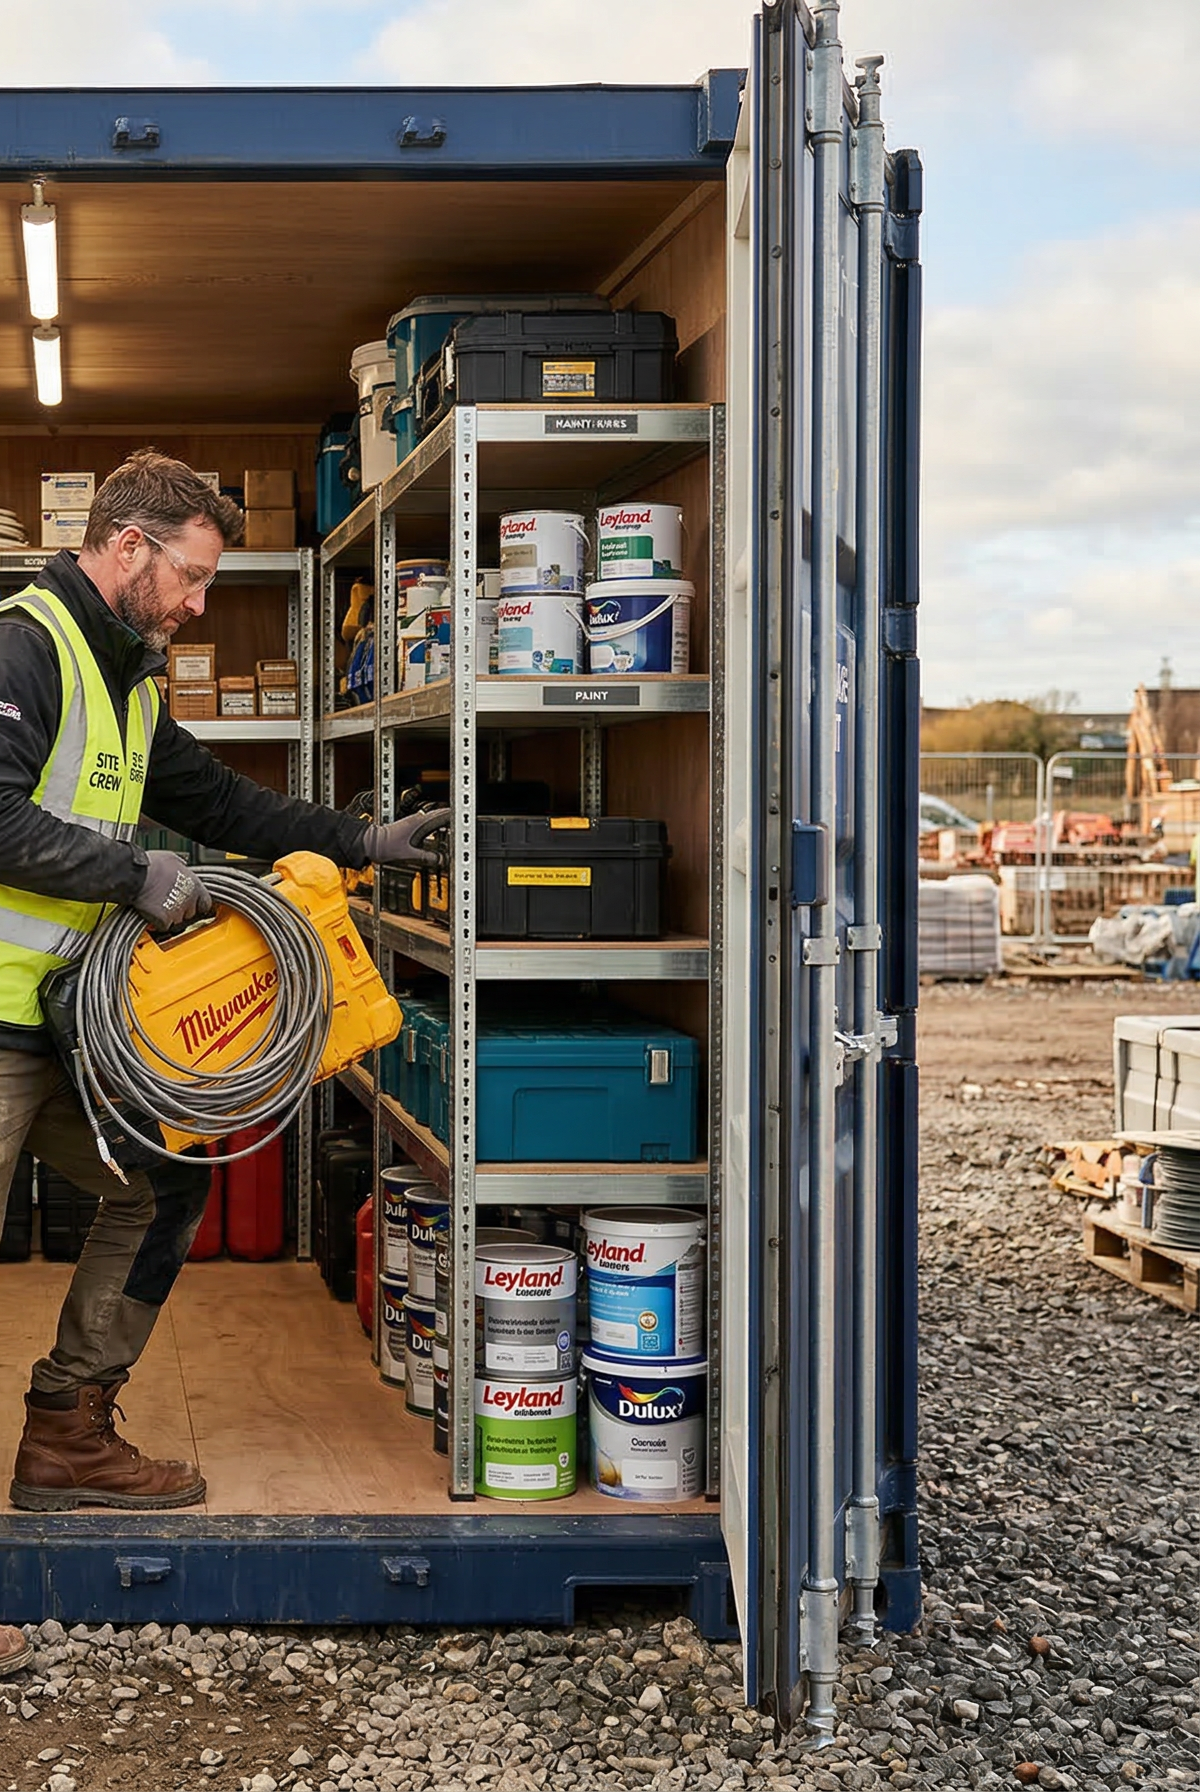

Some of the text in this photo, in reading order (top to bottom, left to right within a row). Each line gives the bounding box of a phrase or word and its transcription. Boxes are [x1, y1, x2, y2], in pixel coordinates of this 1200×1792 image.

[96, 752, 119, 771] SITE
[89, 771, 122, 792] CREW
[587, 1239, 644, 1262] eyland
[484, 1265, 564, 1292] Leyland
[385, 1305, 405, 1323] Du
[483, 1385, 564, 1411] Leyland
[619, 1400, 678, 1419] Dulux
